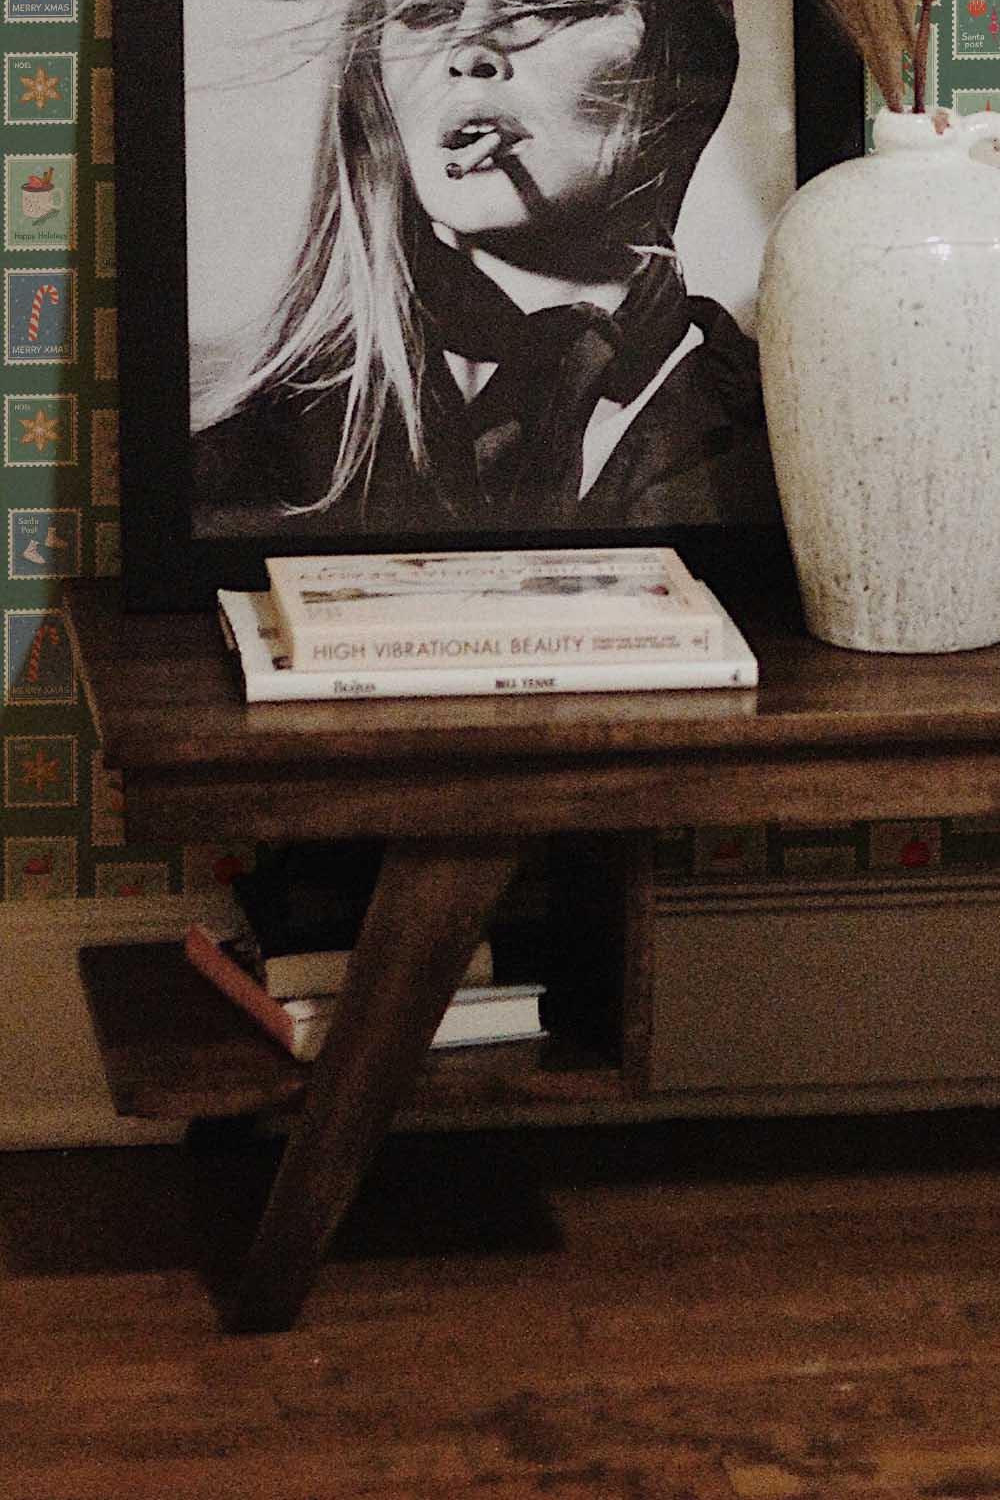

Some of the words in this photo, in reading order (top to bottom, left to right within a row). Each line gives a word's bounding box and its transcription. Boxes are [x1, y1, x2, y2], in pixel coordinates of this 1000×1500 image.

[12, 3, 41, 12] MERRY
[44, 3, 70, 12] XMAS
[312, 642, 366, 661] HIGH
[375, 638, 501, 659] VIBRATIONAL
[510, 634, 584, 654] BEAUTY
